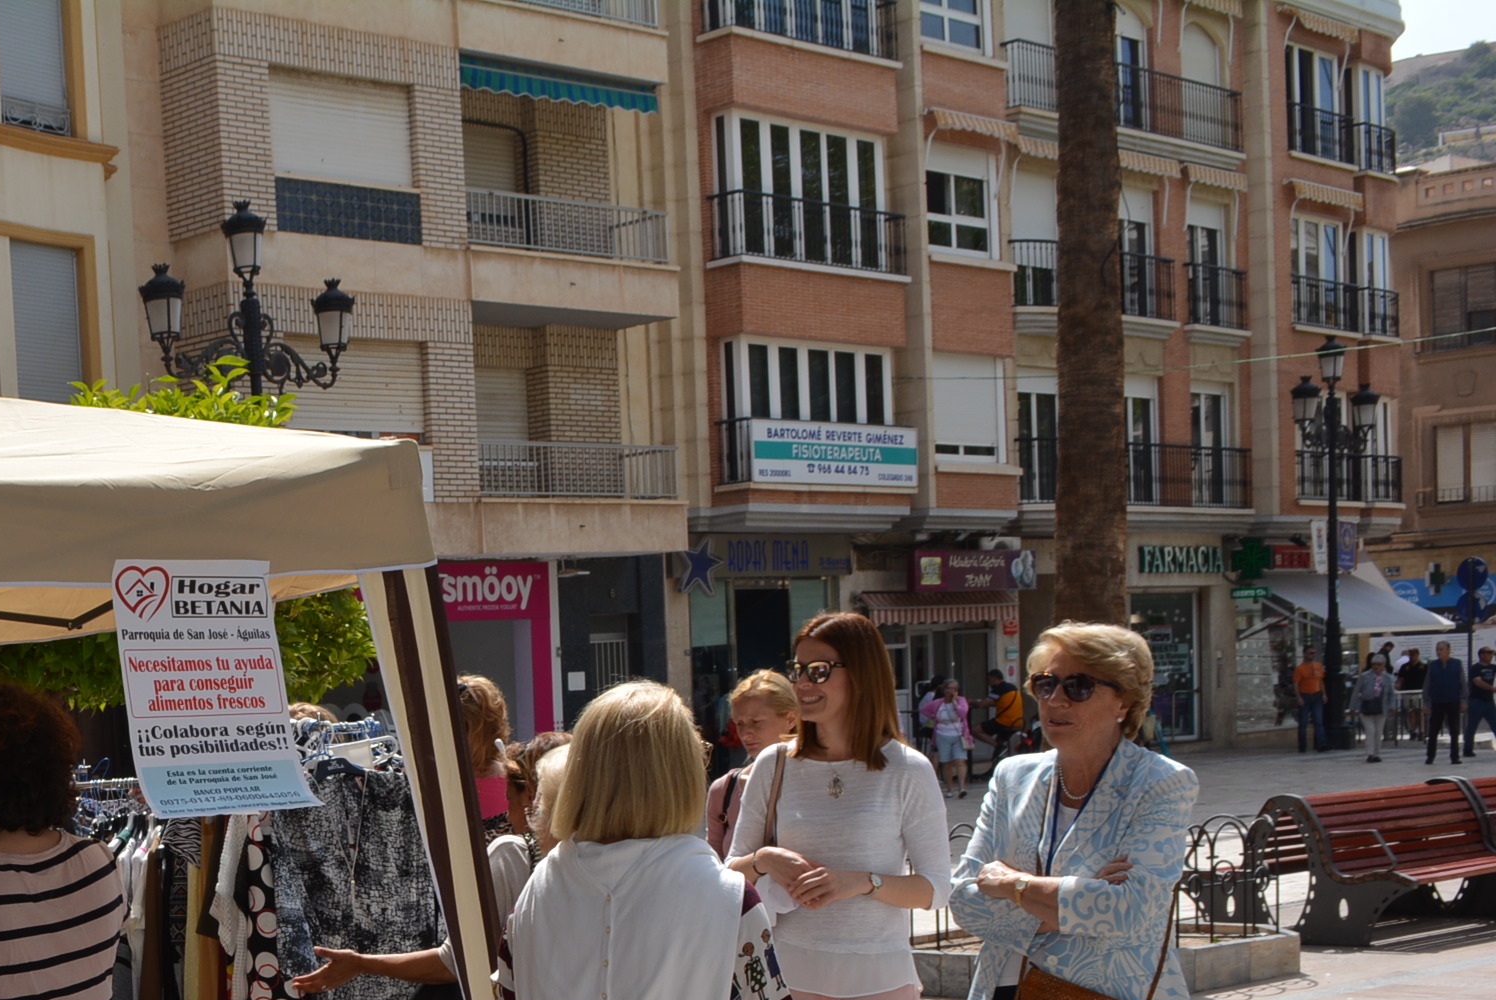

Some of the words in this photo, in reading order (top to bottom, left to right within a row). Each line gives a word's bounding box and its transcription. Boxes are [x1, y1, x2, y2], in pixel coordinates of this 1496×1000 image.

[767, 426, 822, 441] BARTOLOMÉ
[826, 430, 862, 443] REVERTE
[866, 430, 904, 445] GIMÉNEZ
[791, 443, 883, 461] FISIOTERAPEUTA
[834, 464, 845, 474] 44
[772, 540, 809, 571] MENA
[1143, 545, 1225, 573] FARMACIA
[177, 579, 261, 598] Hogar
[441, 566, 533, 611] smöoy
[174, 600, 265, 615] BETANIA
[121, 628, 170, 642] Parroquia
[173, 628, 184, 640] de
[187, 628, 205, 640] San
[207, 628, 228, 640] José
[236, 626, 271, 642] Águilas
[128, 656, 213, 672] Necesitamos
[216, 656, 230, 670] tu
[234, 654, 274, 673] ayuda
[153, 678, 185, 695] para
[189, 673, 254, 693] conseguir
[148, 695, 213, 712] alimentos
[216, 694, 266, 709] frescos
[137, 724, 230, 743] ¡¡Colabora
[236, 721, 286, 738] según
[138, 743, 166, 757] tus
[169, 737, 289, 759] posibilidades!!
[166, 770, 184, 778] Esta
[236, 765, 273, 774] corriente
[189, 776, 230, 785] Parroquia
[260, 772, 278, 780] José
[223, 786, 261, 794] POPULAR
